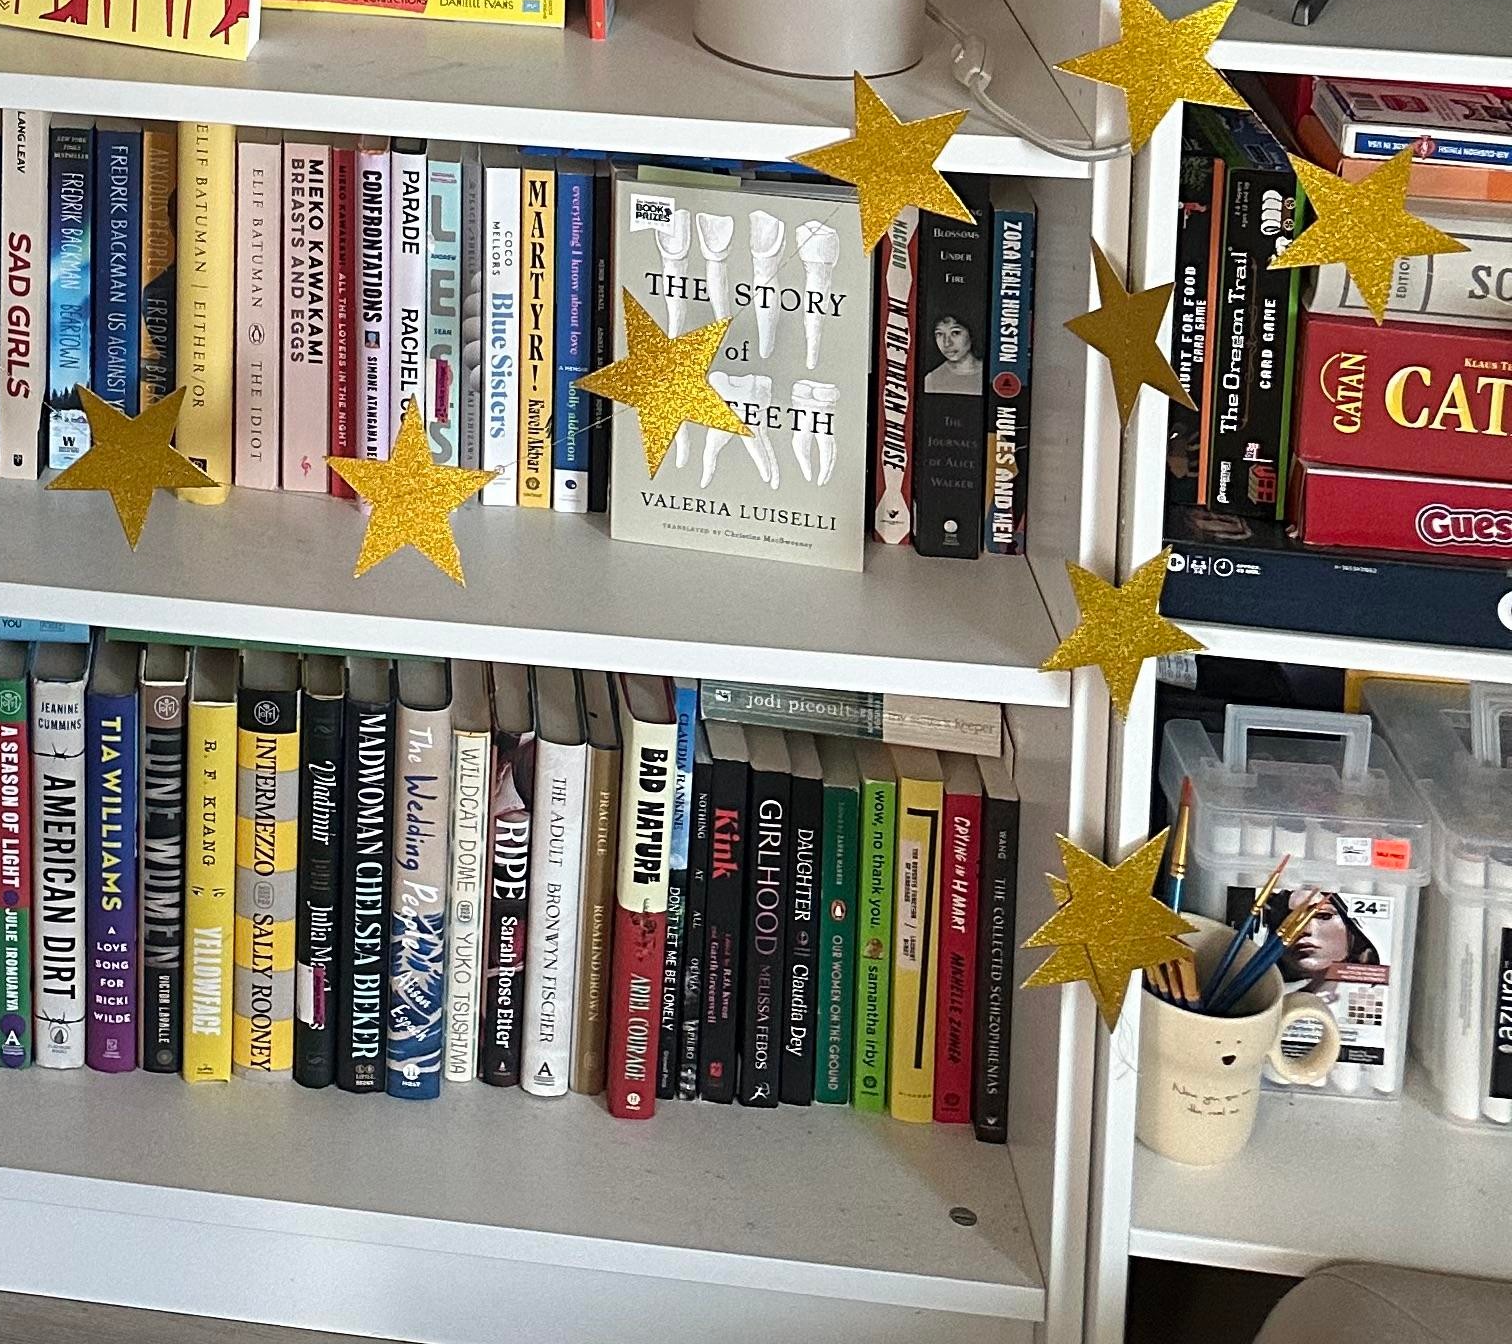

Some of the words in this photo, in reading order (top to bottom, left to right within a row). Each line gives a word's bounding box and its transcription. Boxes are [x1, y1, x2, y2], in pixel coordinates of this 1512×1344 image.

[290, 158, 306, 248] BREASTS
[308, 160, 324, 231] MIEKO
[9, 233, 31, 297] SAD
[290, 257, 304, 299] AND
[529, 179, 546, 391] MARTYR!
[645, 272, 711, 301] THE
[734, 283, 847, 317] STORY
[1229, 253, 1248, 304] Trail
[290, 308, 304, 362] EGGS
[307, 240, 323, 365] KAWAKAMI
[491, 293, 514, 352] Blue
[1261, 298, 1277, 342] GAME
[7, 305, 31, 400] GIRLS
[725, 339, 750, 362] of
[1223, 308, 1244, 391] Oregon
[1259, 347, 1273, 390] CARD
[490, 356, 512, 438] Sisters
[1220, 393, 1239, 434] The
[1332, 352, 1368, 434] CATAN
[640, 492, 731, 517] VALERIA
[740, 504, 837, 531] LUISELLI
[100, 717, 122, 764] TIA
[639, 748, 669, 793] BAD
[254, 736, 278, 877] INTERMEZZO
[356, 713, 387, 854] MADWOMAN
[43, 775, 77, 928] AMERICAN
[99, 770, 122, 910] WILLIAMS
[494, 819, 529, 900] RIPE
[632, 800, 667, 885] NATURE
[712, 809, 739, 880] Kink
[354, 861, 383, 965] CHELSEA
[754, 800, 783, 956] GIRLHOOD
[1354, 900, 1378, 915] 24
[43, 935, 75, 1000] DIRT
[250, 913, 274, 973] SALLY
[248, 981, 274, 1071] ROONEY
[352, 975, 381, 1059] BIEKER
